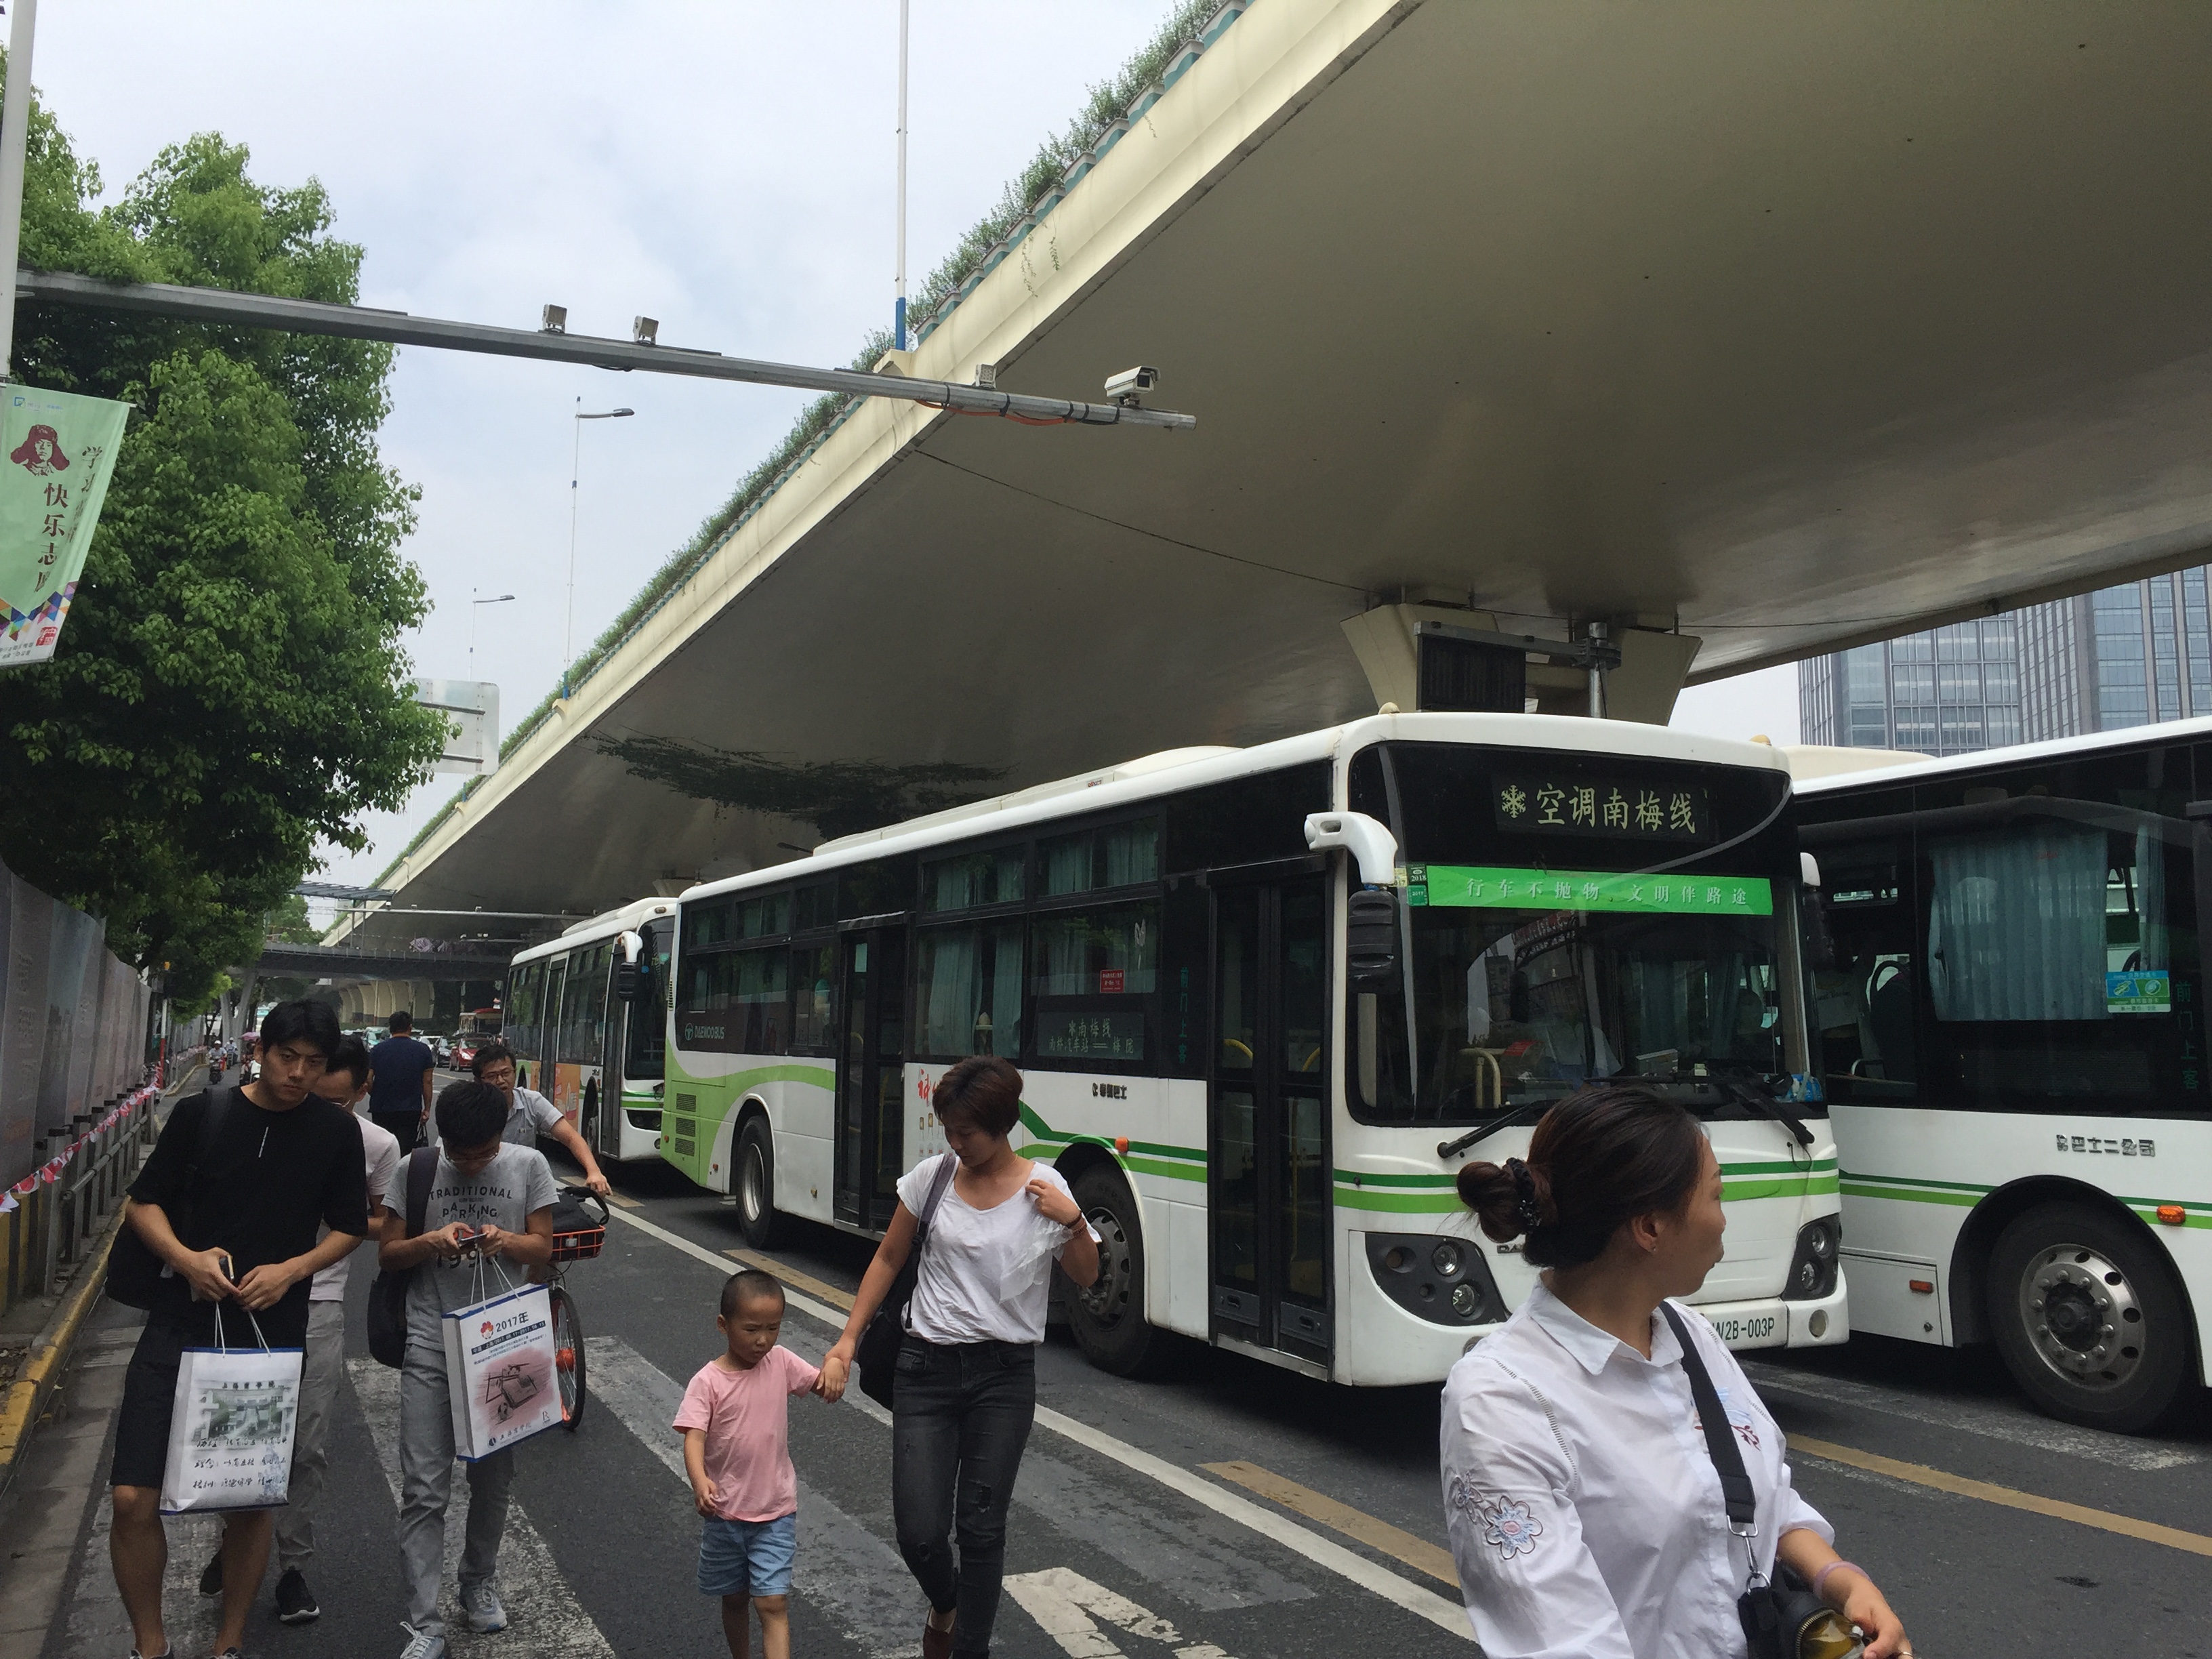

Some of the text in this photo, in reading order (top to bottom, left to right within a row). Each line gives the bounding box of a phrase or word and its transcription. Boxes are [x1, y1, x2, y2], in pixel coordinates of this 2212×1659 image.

[1536, 783, 1696, 834] 空调南梅线
[1467, 878, 1747, 905] 行车不抛物 文明伴路途
[2175, 981, 2198, 1090] 前门上客
[2071, 1135, 2156, 1157] 巴士二公司
[430, 1186, 512, 1200] TRADITIONAL
[443, 1202, 497, 1219] PARKING
[495, 1311, 529, 1332] 2017年
